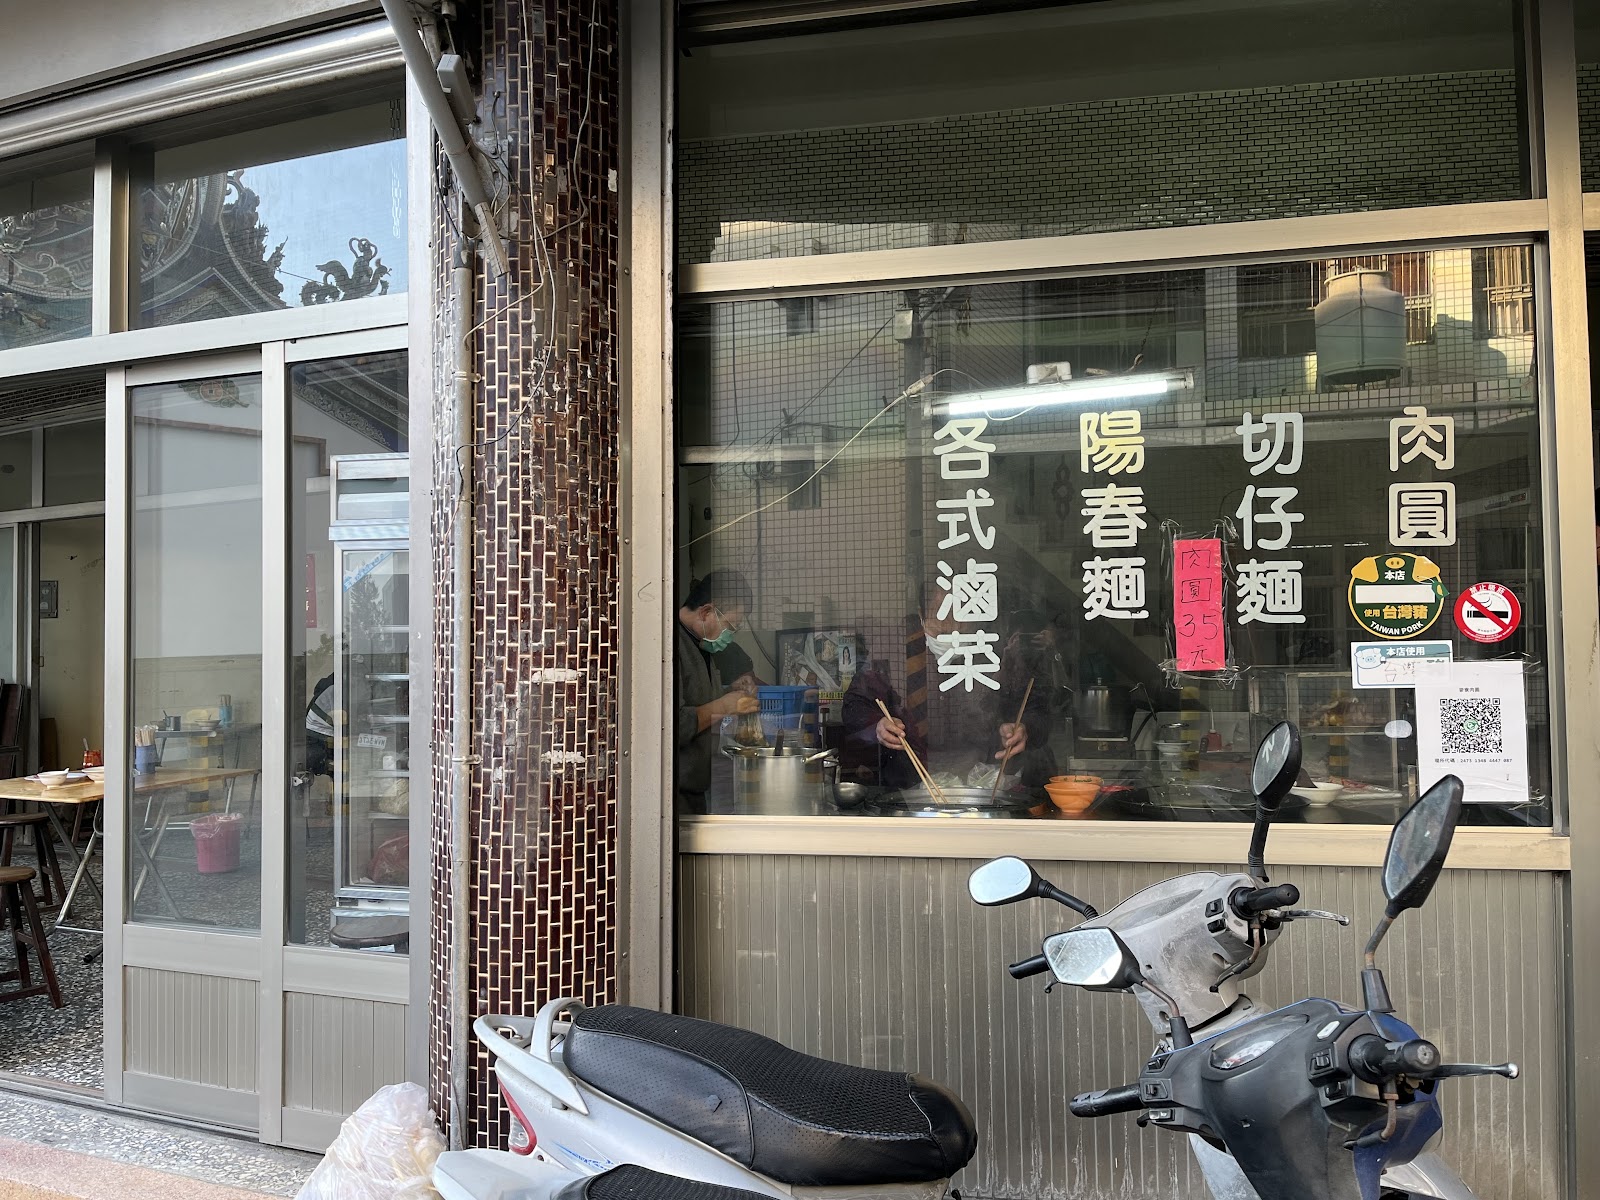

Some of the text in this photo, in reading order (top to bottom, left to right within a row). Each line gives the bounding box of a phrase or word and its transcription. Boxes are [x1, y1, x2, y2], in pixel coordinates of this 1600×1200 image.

[1080, 410, 1149, 620] 陽春麵
[1389, 407, 1455, 546] 肉圓
[933, 418, 1001, 693] 各式滷菜
[1236, 412, 1306, 624] 切仔麵
[1364, 604, 1429, 620] 使用 台灣豬
[1384, 569, 1406, 581] 本店
[1370, 620, 1424, 635] TAIWAN PORK
[1386, 646, 1426, 656] 本店使用
